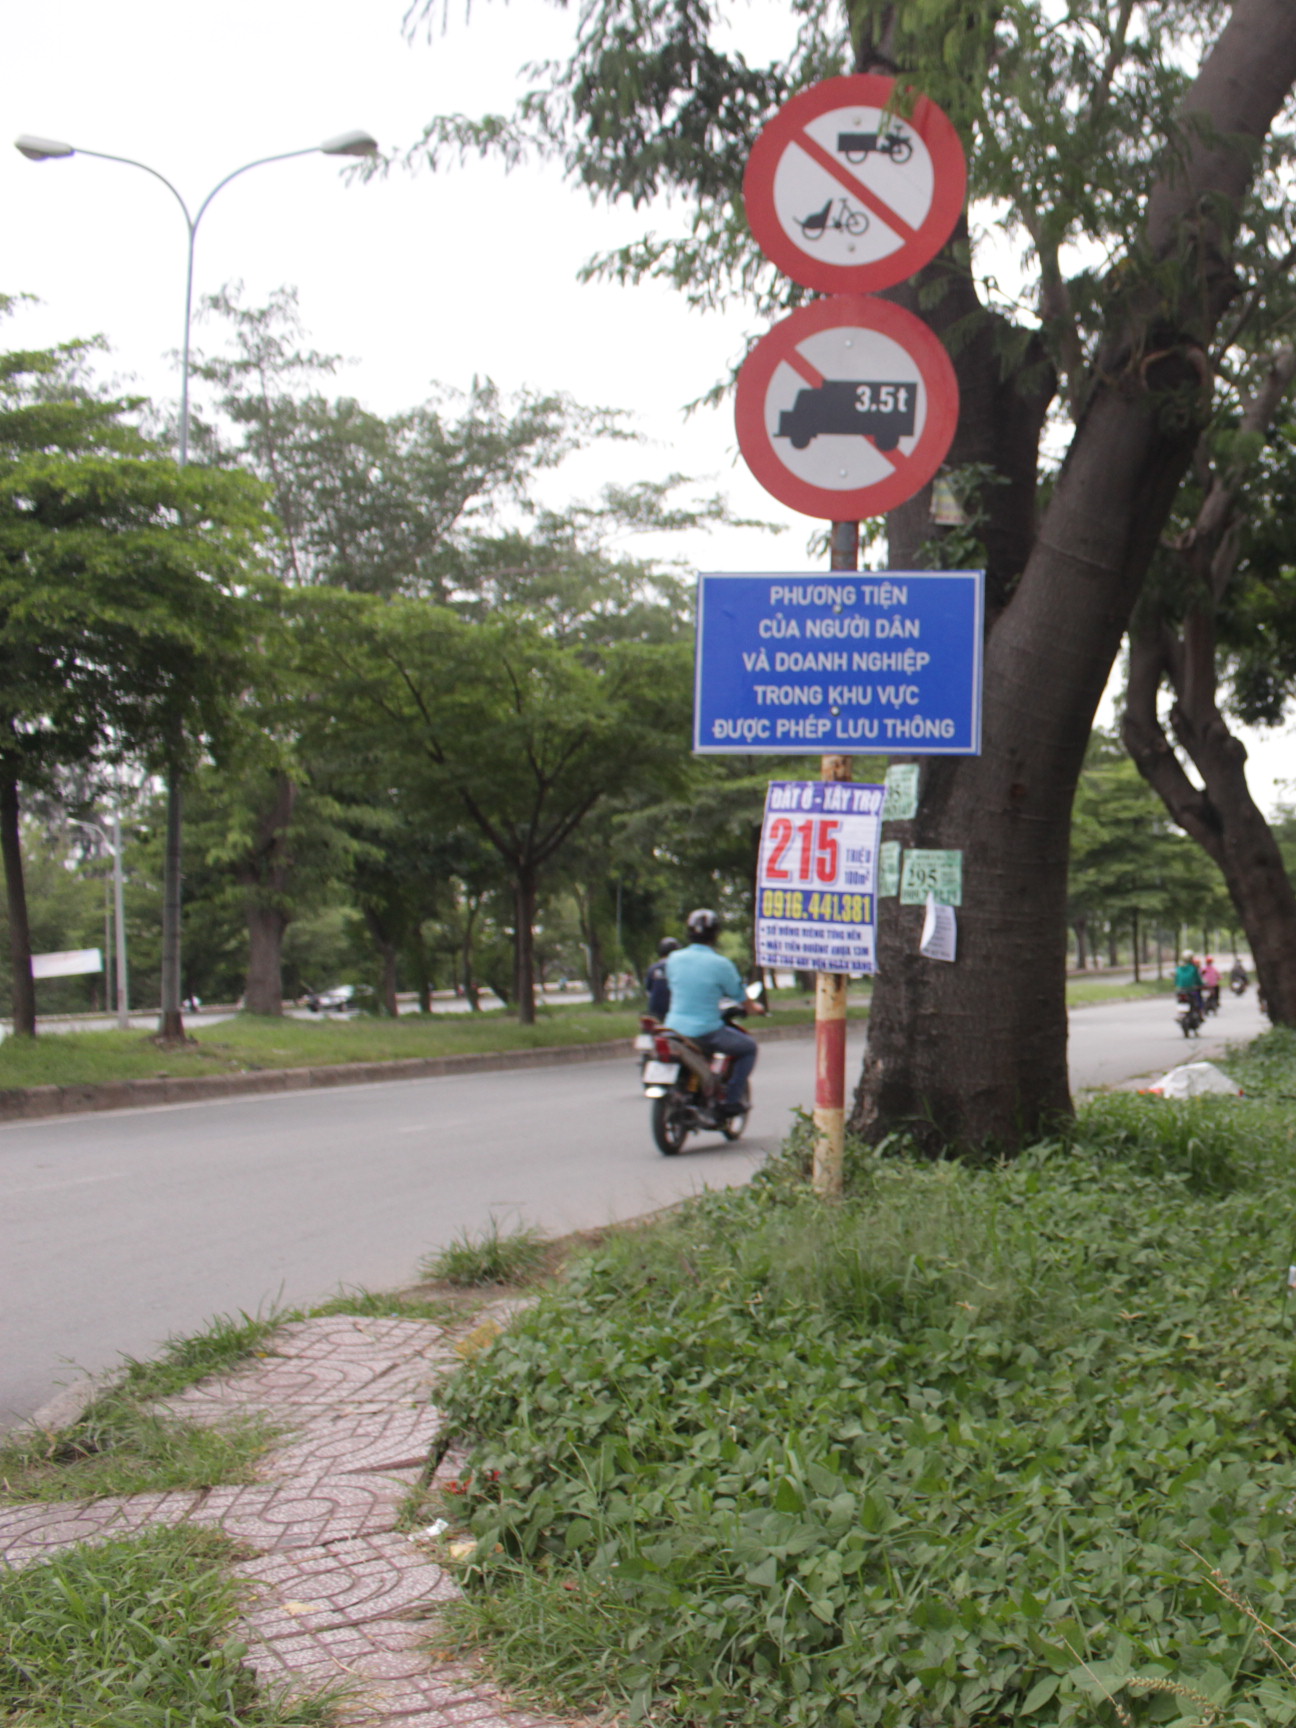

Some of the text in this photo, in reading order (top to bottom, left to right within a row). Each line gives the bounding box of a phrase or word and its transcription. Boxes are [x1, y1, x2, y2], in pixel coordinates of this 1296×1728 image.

[855, 385, 909, 413] 3.5t
[769, 582, 908, 608] PHƯƠNG TIỆN
[758, 613, 920, 638] CỦA NGƯỜI DÂN
[742, 648, 930, 675] VÀ DOANH NGHIỆP
[753, 685, 920, 709] TRONG KHU VỰC
[712, 714, 955, 742] ĐƯỢC PHÉP LƯU THÔNG
[822, 785, 852, 812] XÂY
[852, 789, 882, 816] TRỌ
[766, 818, 839, 883] 215
